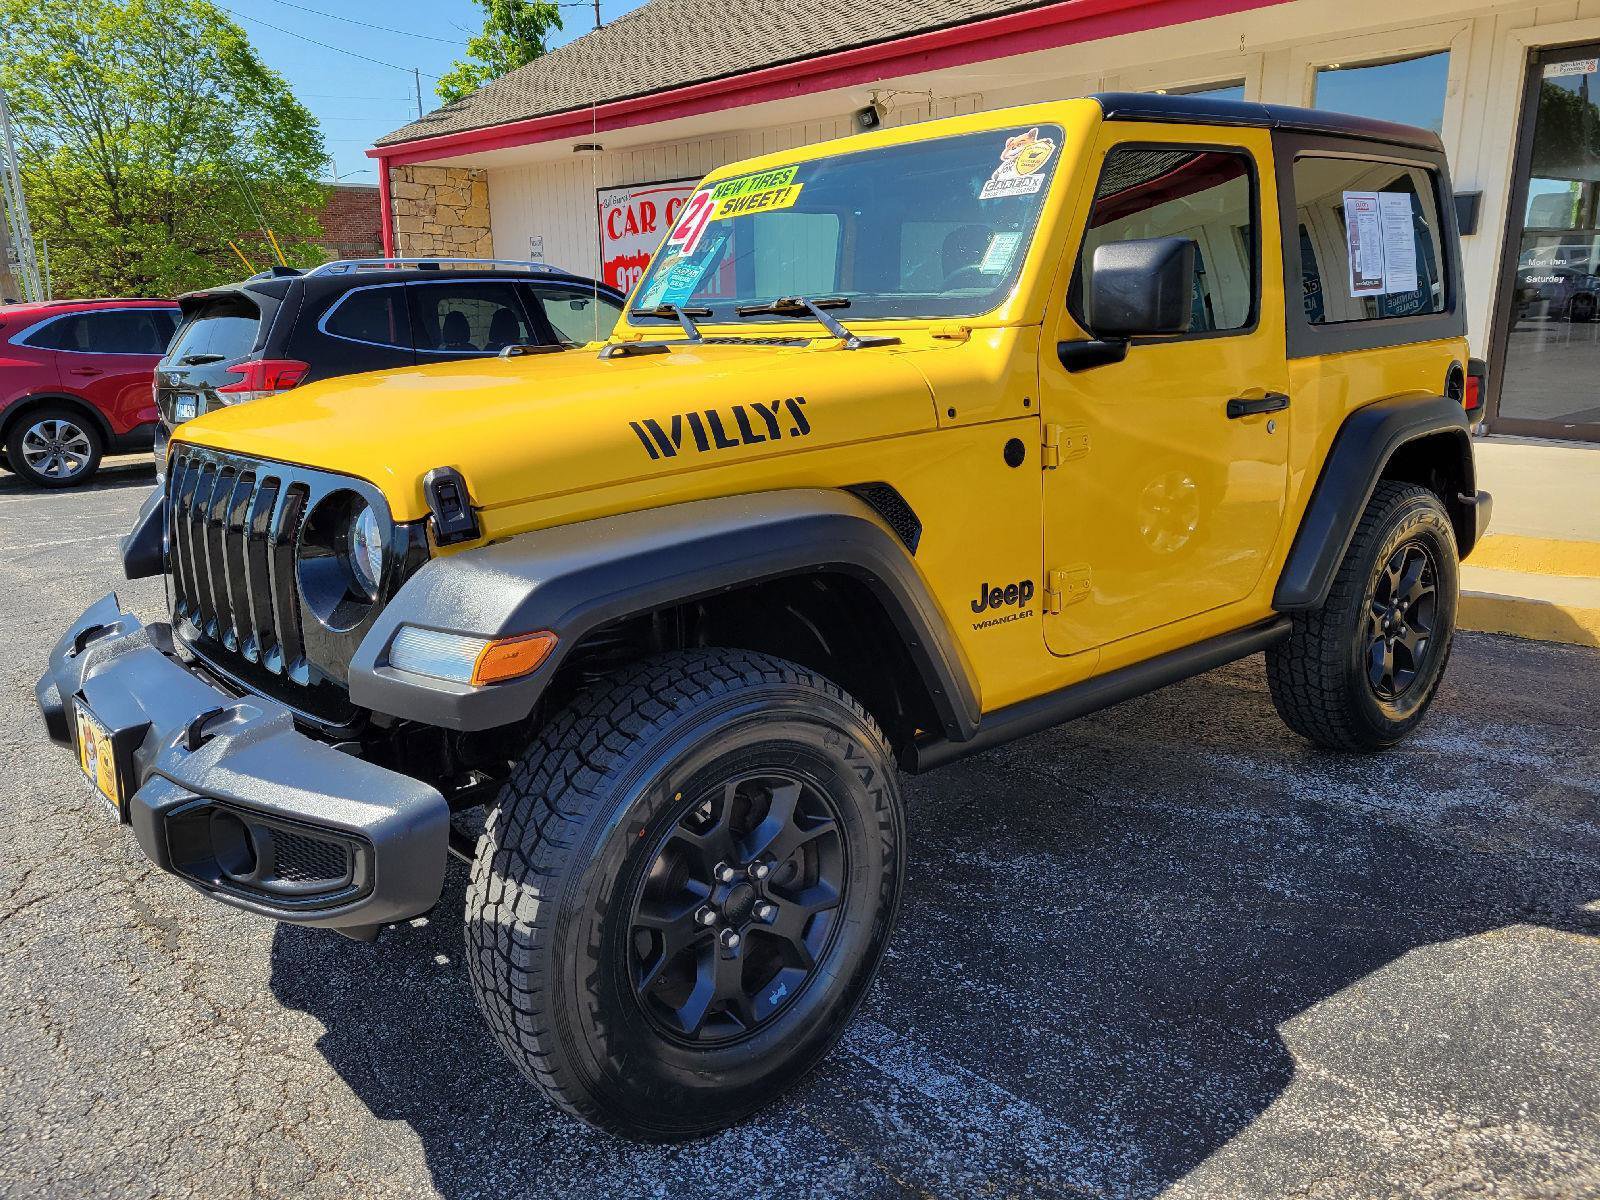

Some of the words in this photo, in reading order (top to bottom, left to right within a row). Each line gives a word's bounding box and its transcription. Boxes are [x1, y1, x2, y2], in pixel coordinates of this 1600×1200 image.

[711, 178, 748, 200] NEW
[747, 169, 792, 192] TIRES
[720, 186, 792, 216] SWEET!
[607, 200, 657, 241] CAR
[672, 192, 715, 253] 21
[1526, 275, 1564, 284] Saturday
[628, 396, 811, 461] WILLYS
[970, 579, 1034, 614] Jeep
[971, 609, 1034, 631] WRANGLER
